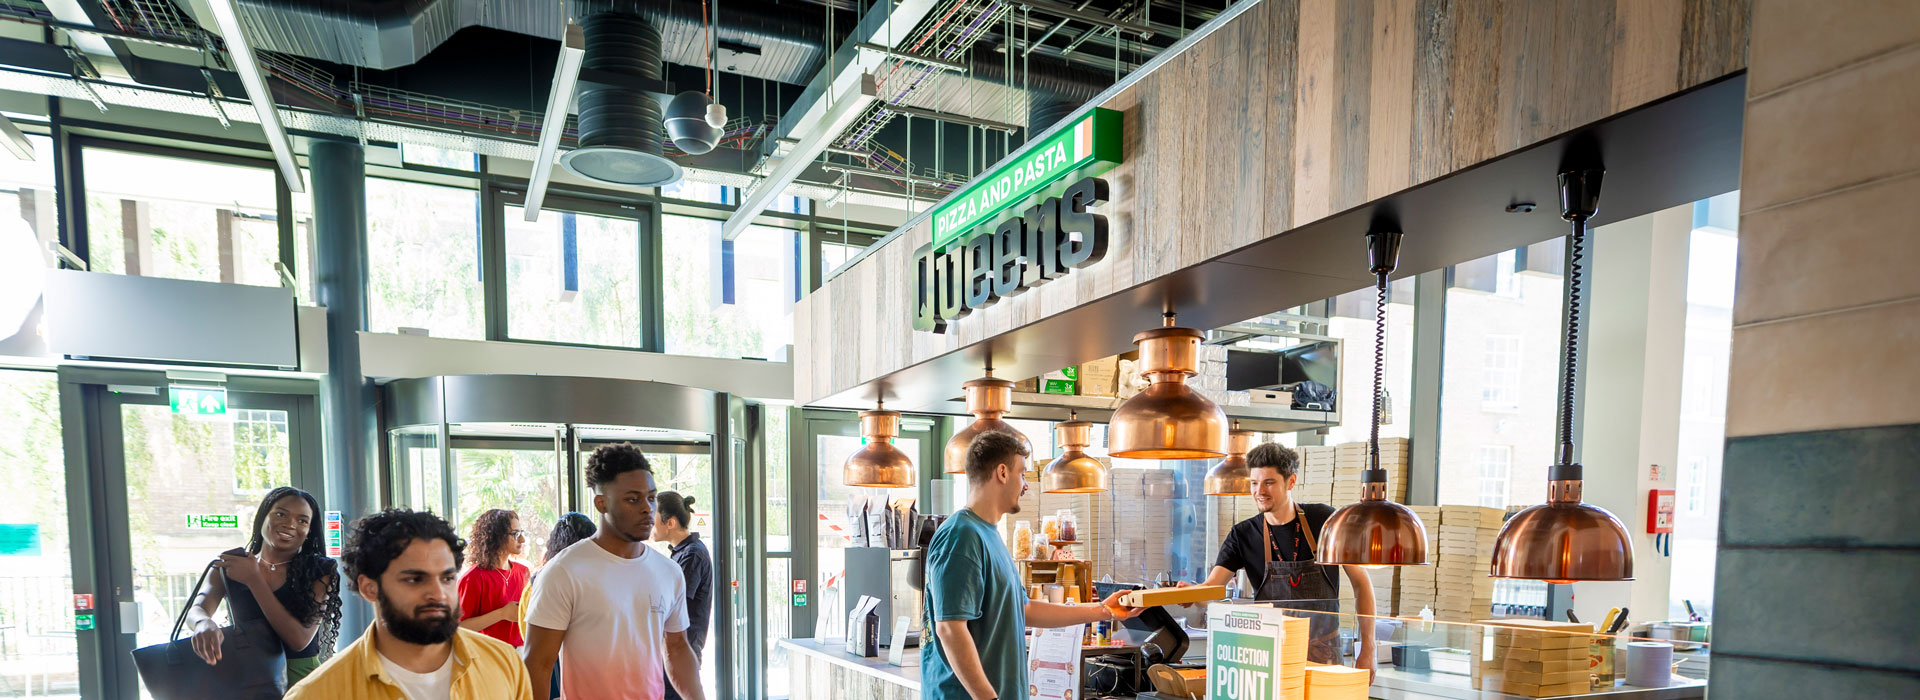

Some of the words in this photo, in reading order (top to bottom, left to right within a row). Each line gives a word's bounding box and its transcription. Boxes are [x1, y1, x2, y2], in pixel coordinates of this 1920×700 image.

[938, 200, 977, 238] PIZZA
[979, 179, 1011, 214] AND
[1014, 140, 1067, 193] PASTA
[912, 177, 1109, 334] Queens
[1224, 614, 1261, 630] Queens
[1217, 644, 1269, 667] COLLECTION
[1216, 664, 1269, 700] POINT
